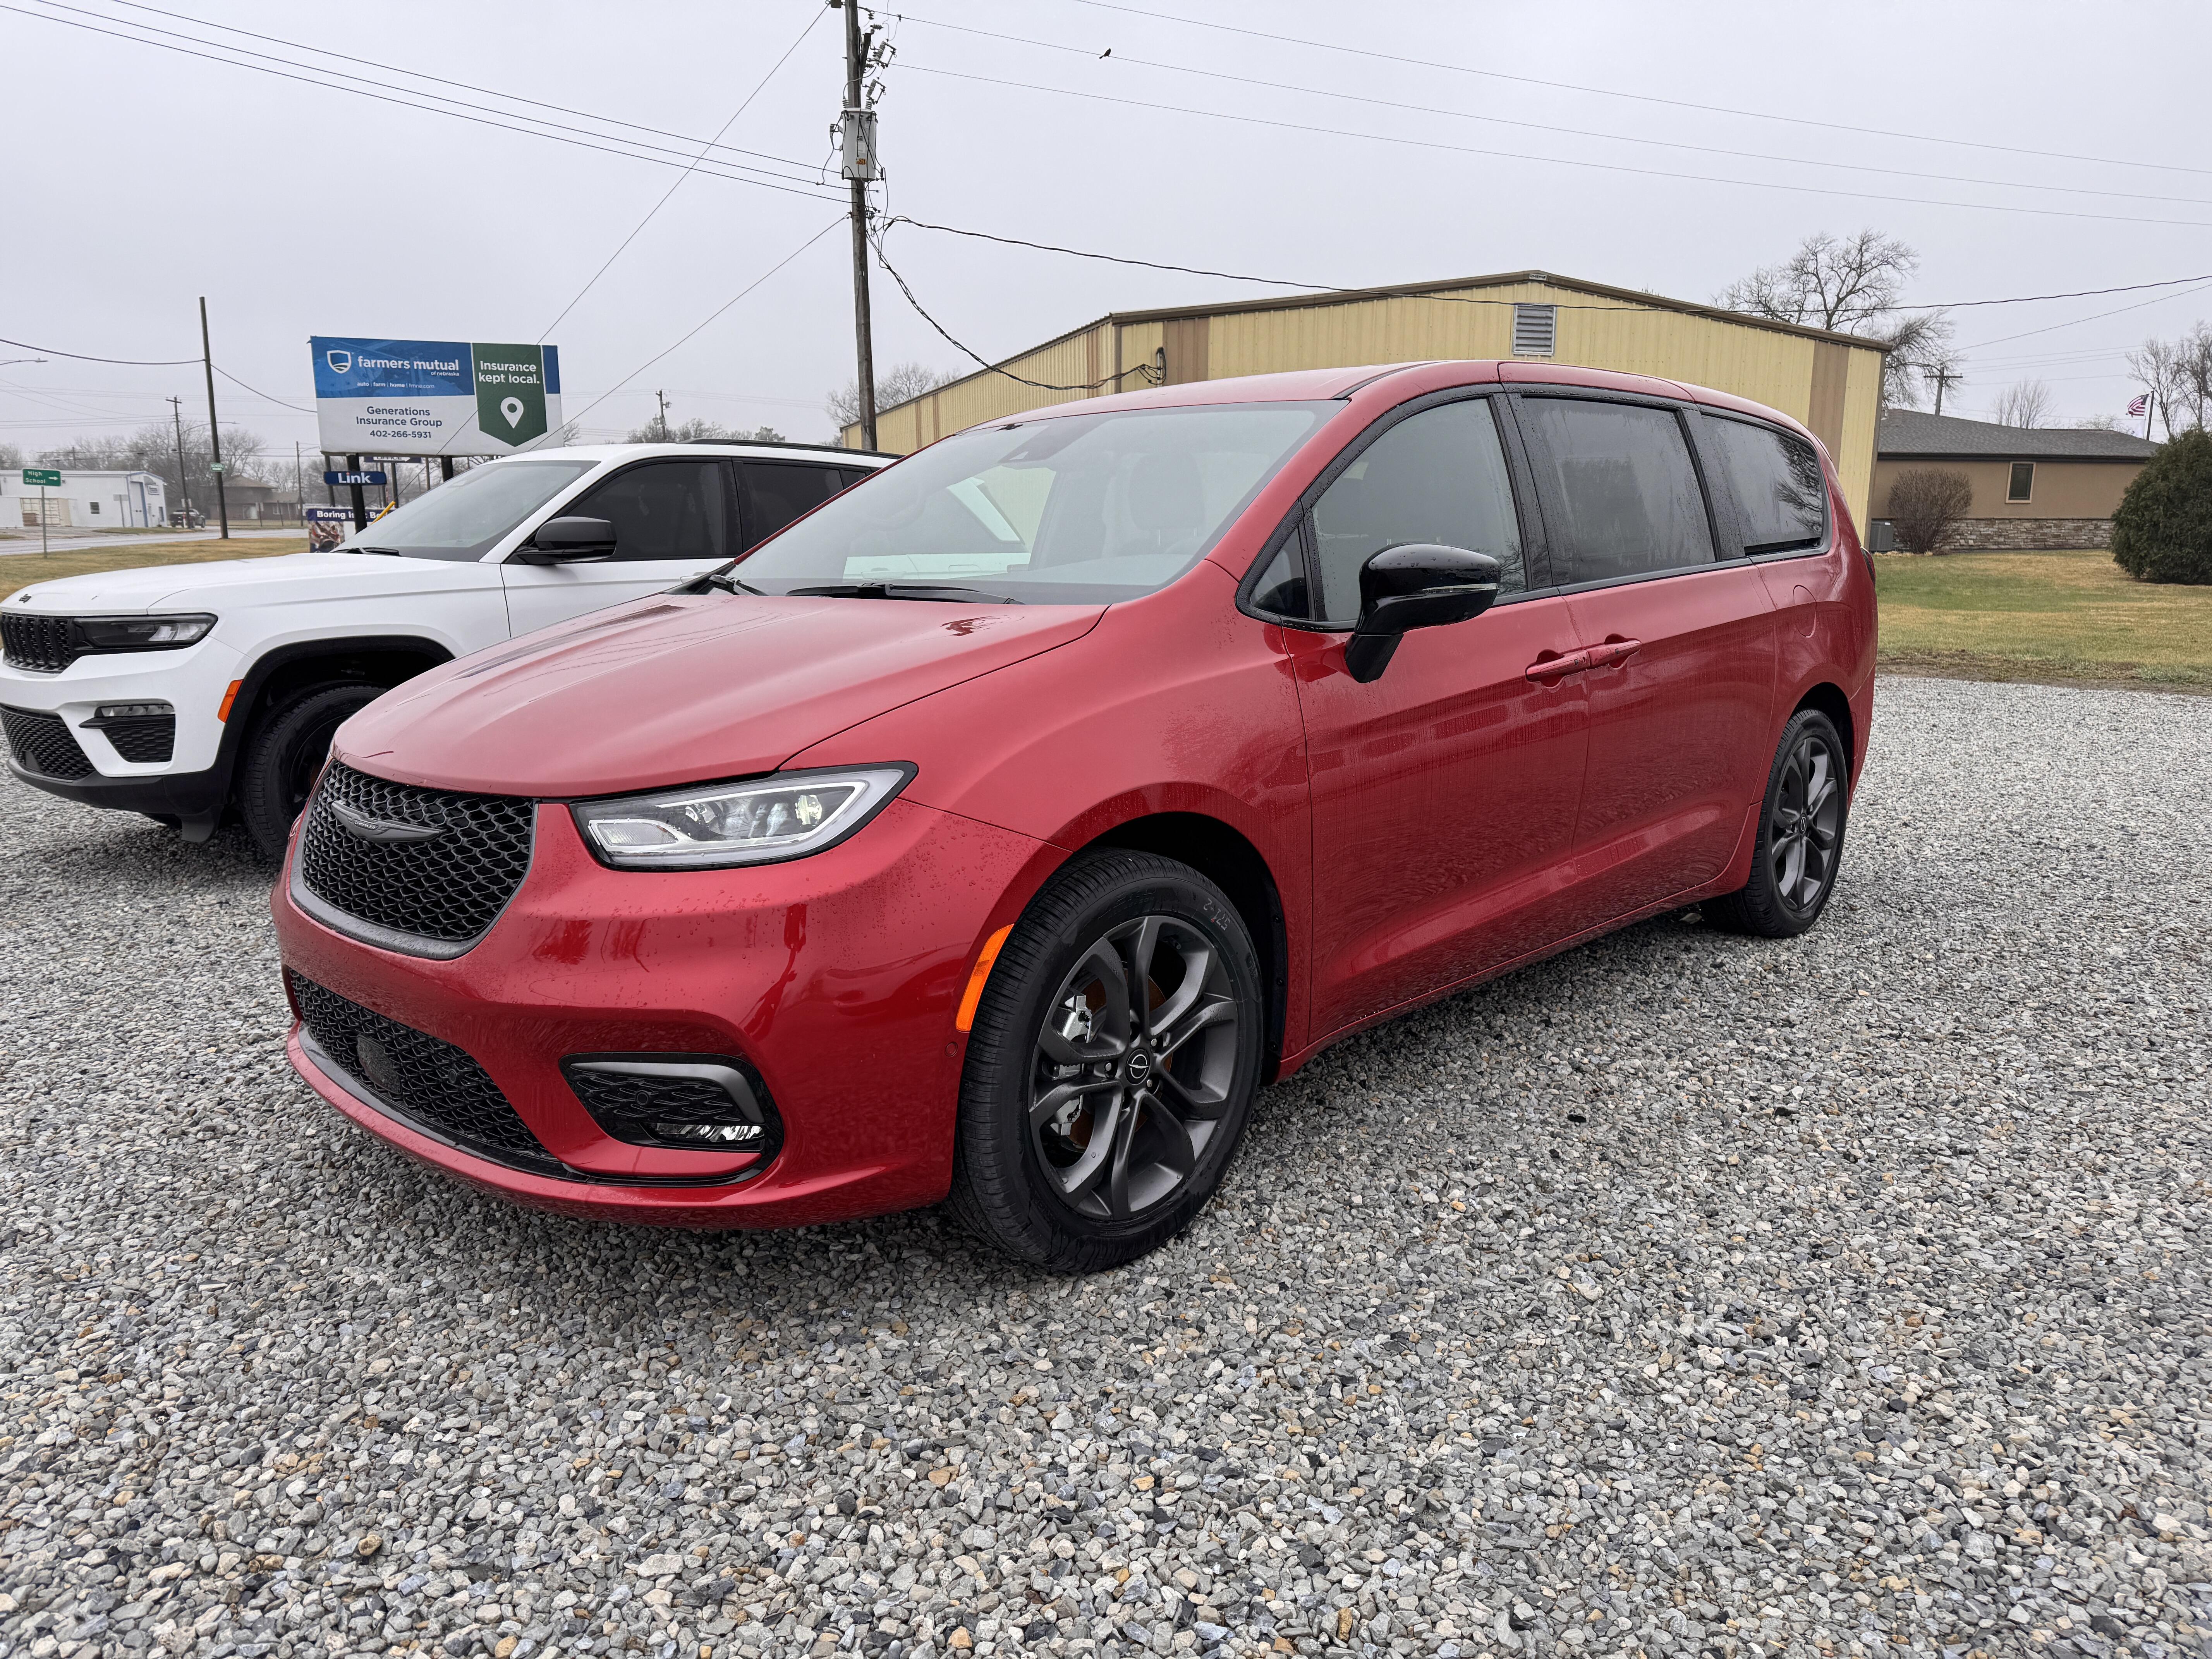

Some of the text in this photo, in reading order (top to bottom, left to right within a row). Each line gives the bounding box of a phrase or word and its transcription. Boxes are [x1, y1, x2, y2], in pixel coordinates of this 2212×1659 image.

[358, 356, 459, 371] farmers mutual
[480, 361, 536, 372] Insurance
[478, 372, 540, 384] kept local.
[366, 406, 430, 416] Generations
[356, 416, 442, 428] Insurance Group
[369, 430, 431, 438] 402-266-5931
[338, 472, 371, 484] Link
[317, 510, 346, 520] Boring
